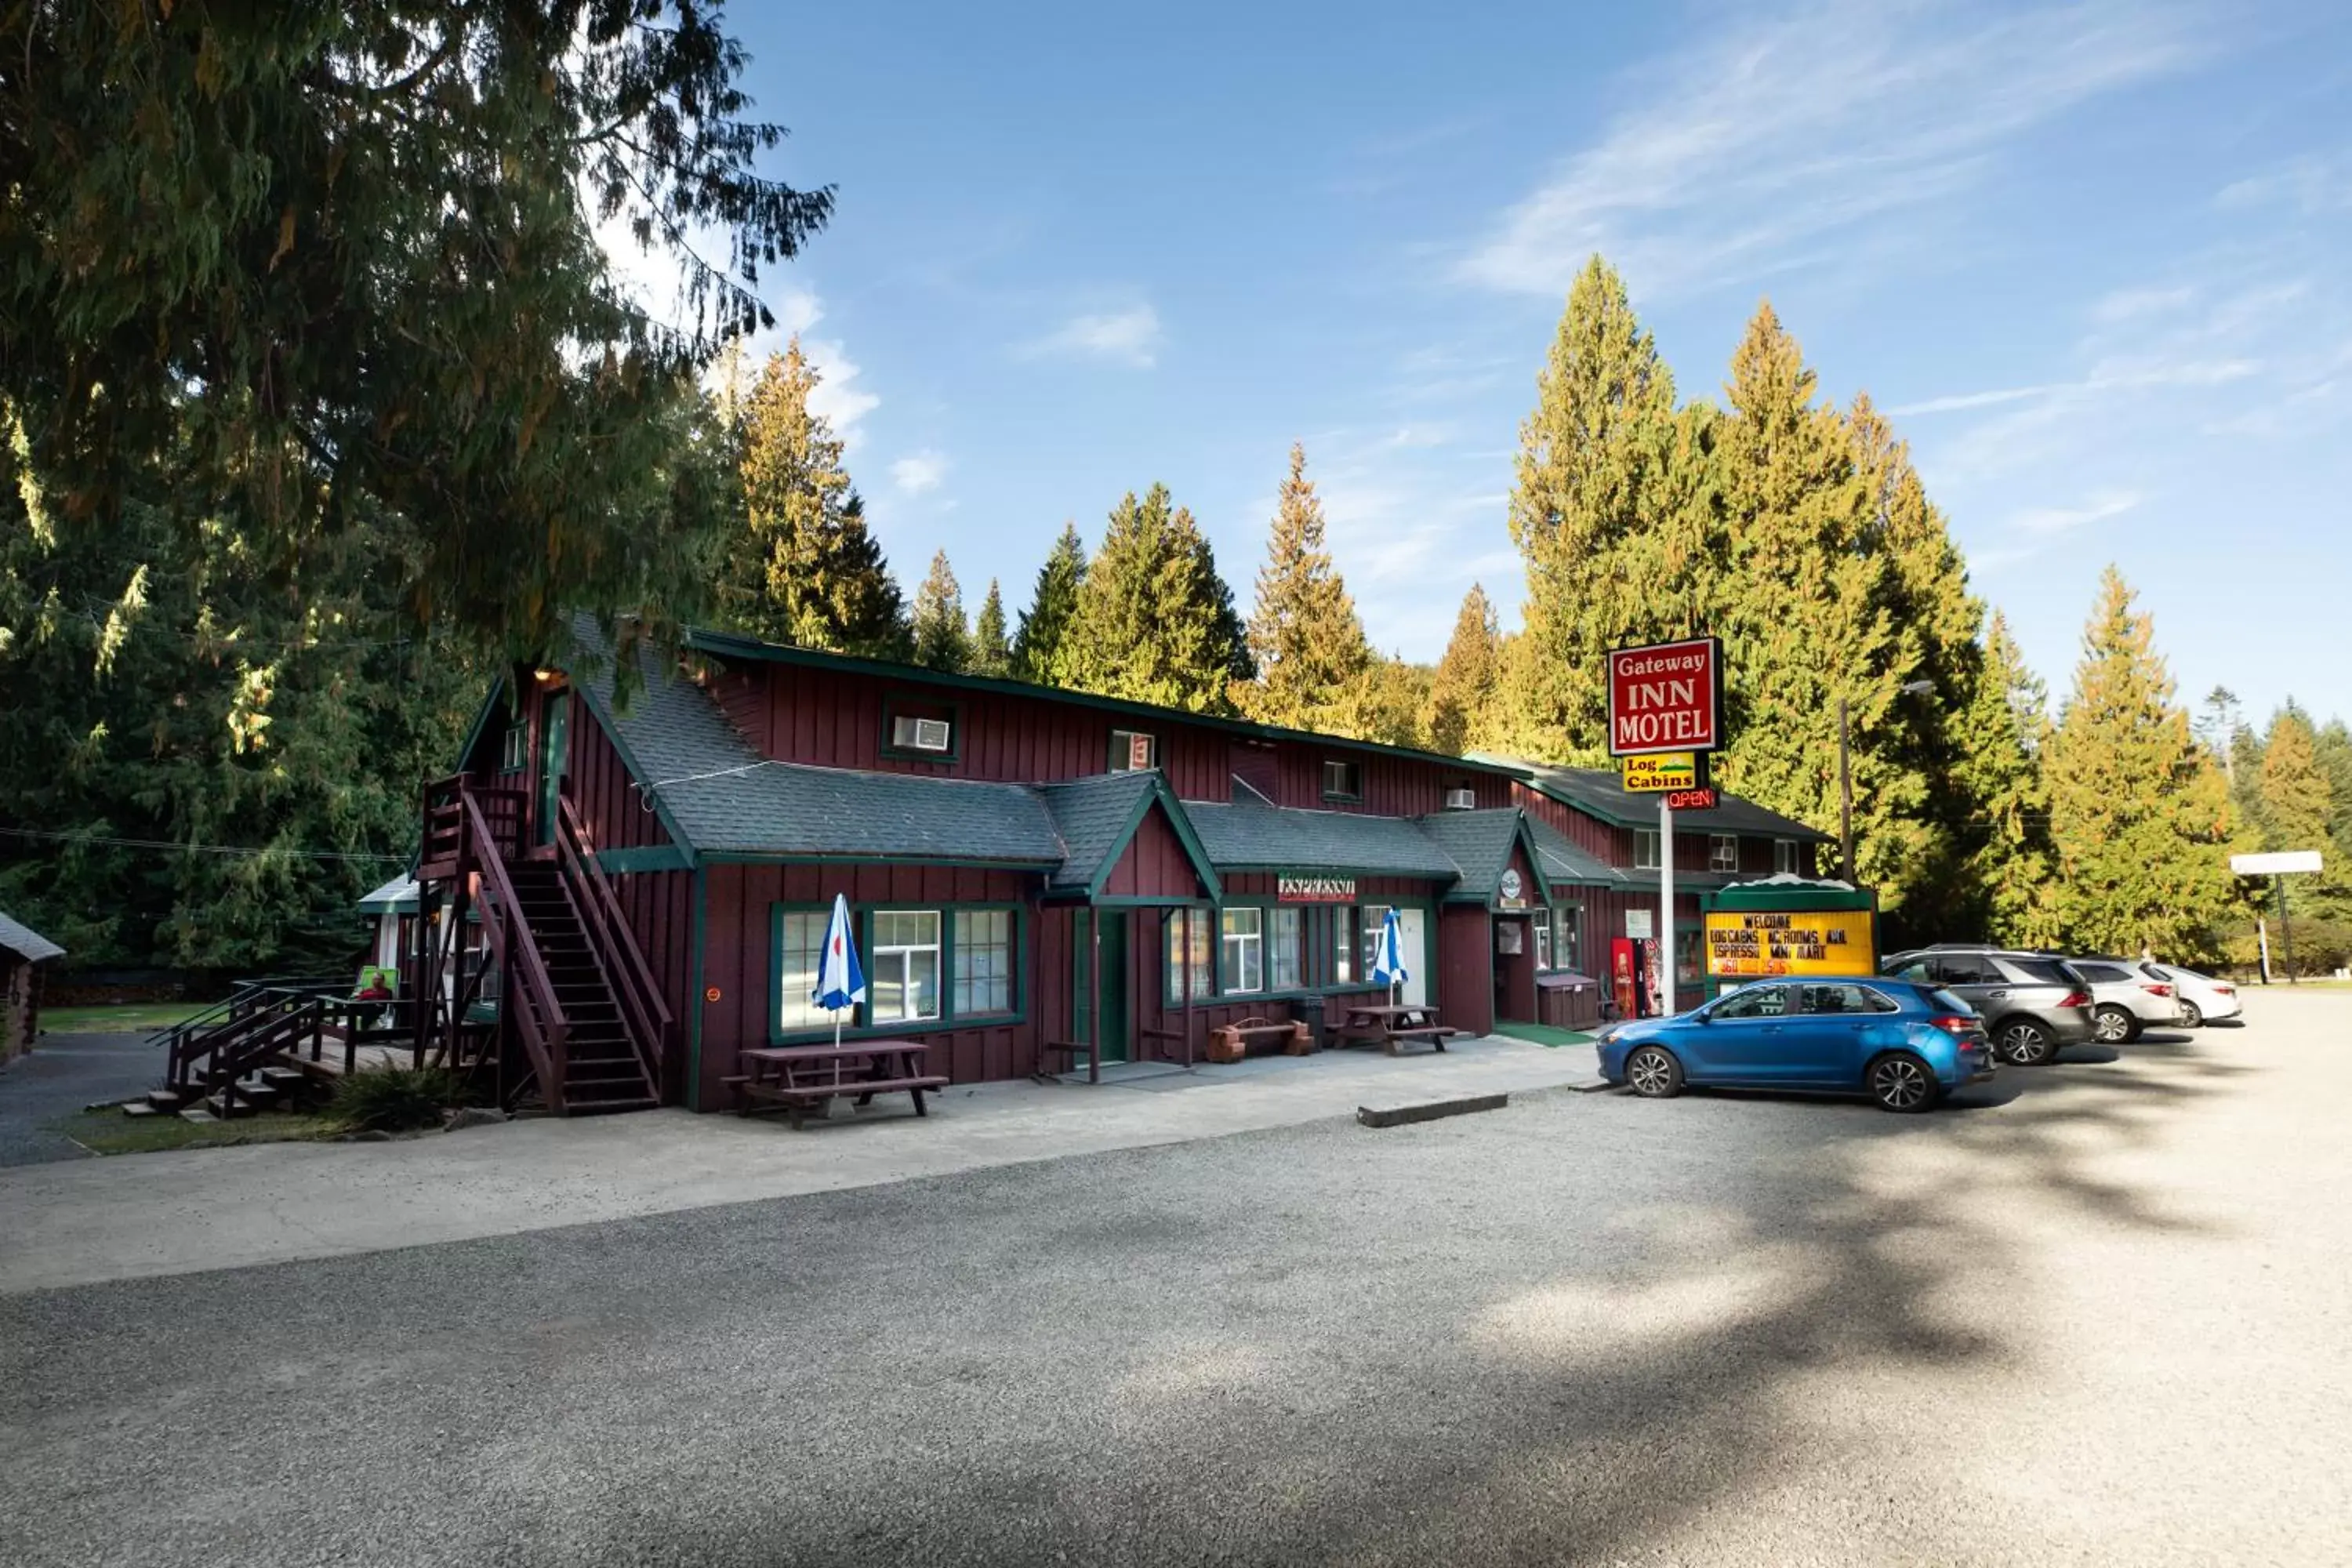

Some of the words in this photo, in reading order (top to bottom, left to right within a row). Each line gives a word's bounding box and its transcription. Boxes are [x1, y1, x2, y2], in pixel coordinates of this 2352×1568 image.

[1618, 654, 1705, 677] Gateway
[1628, 678, 1695, 710] INN
[1619, 710, 1708, 744] MOTEL
[1628, 758, 1657, 772] Log
[1627, 773, 1693, 789] Cabins
[1670, 790, 1710, 807] OPEN
[1744, 916, 1791, 929] WELCOME
[1710, 930, 1726, 943] LOG
[1784, 930, 1819, 945] ROOMS
[1715, 945, 1760, 959] ESPRESSO
[1796, 946, 1827, 960] MART
